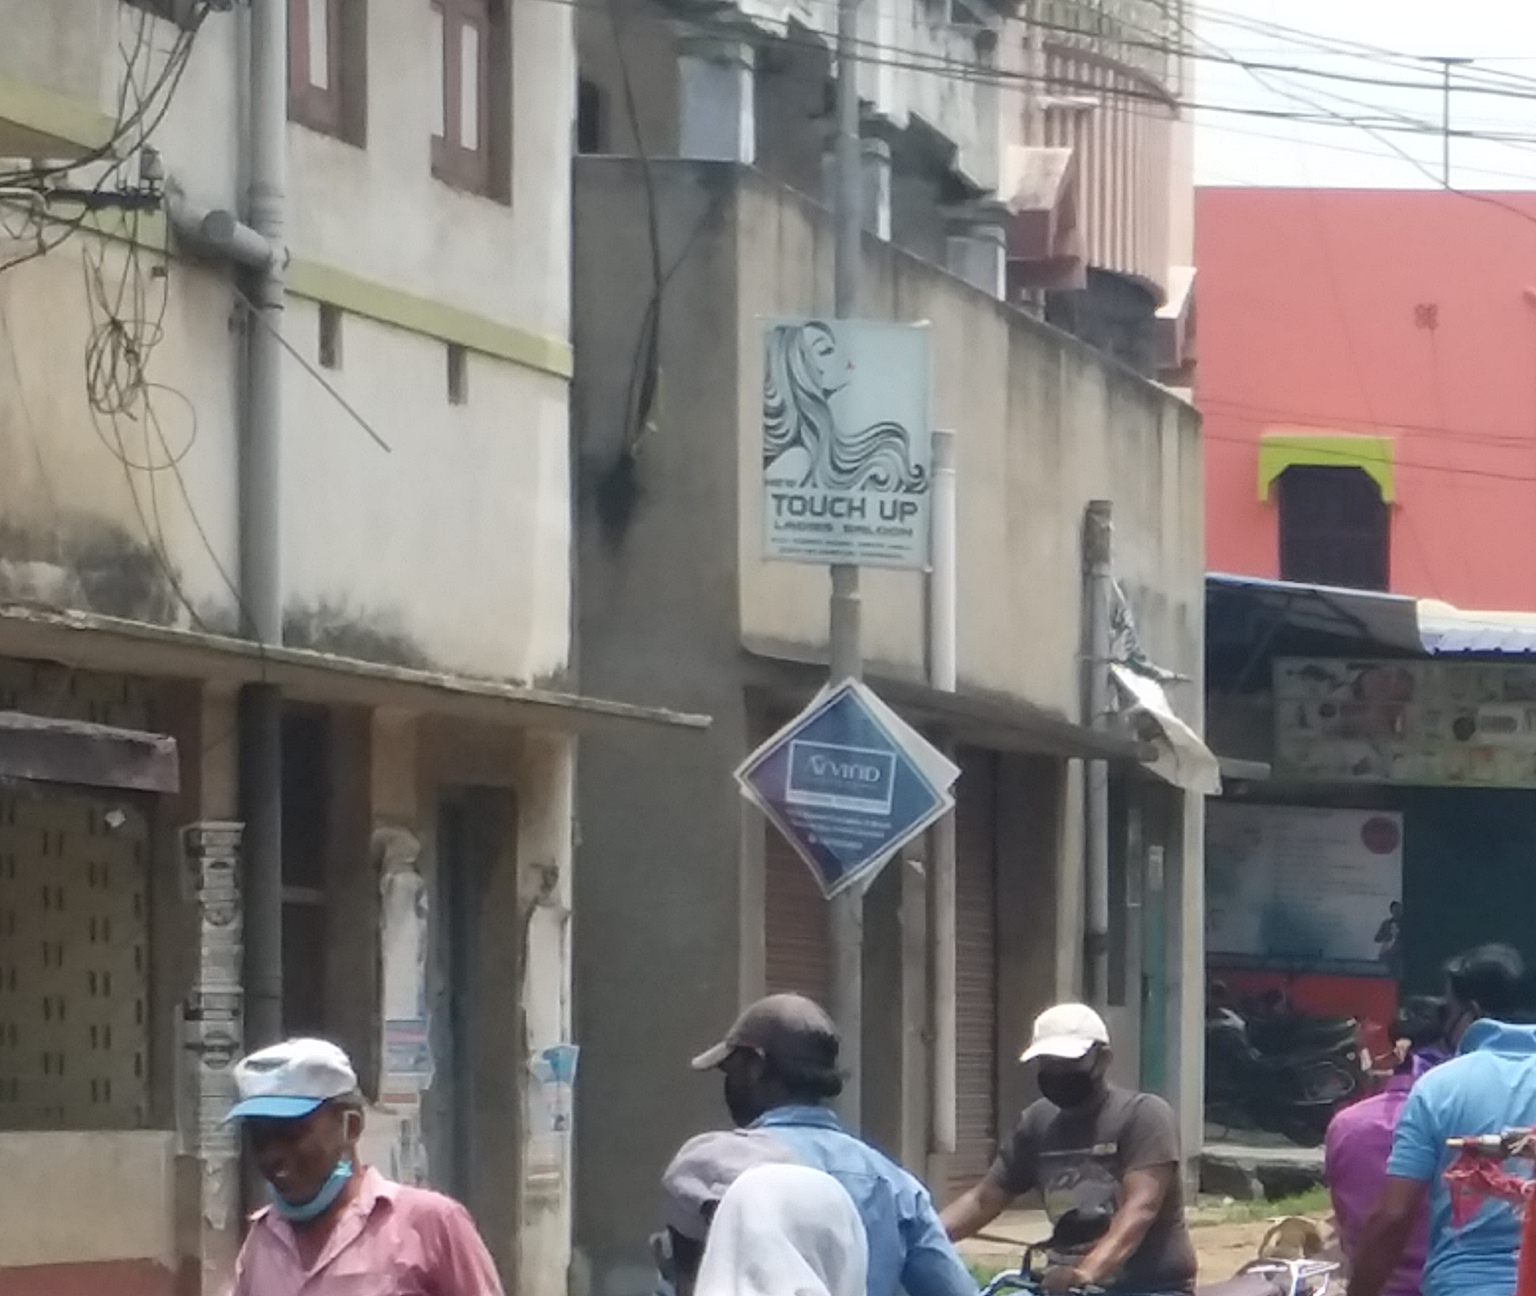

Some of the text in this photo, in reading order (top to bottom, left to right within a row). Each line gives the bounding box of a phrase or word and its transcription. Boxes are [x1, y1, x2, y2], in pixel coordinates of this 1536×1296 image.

[771, 494, 918, 522] TOUCH UP
[774, 520, 913, 537] LADIES SALOON
